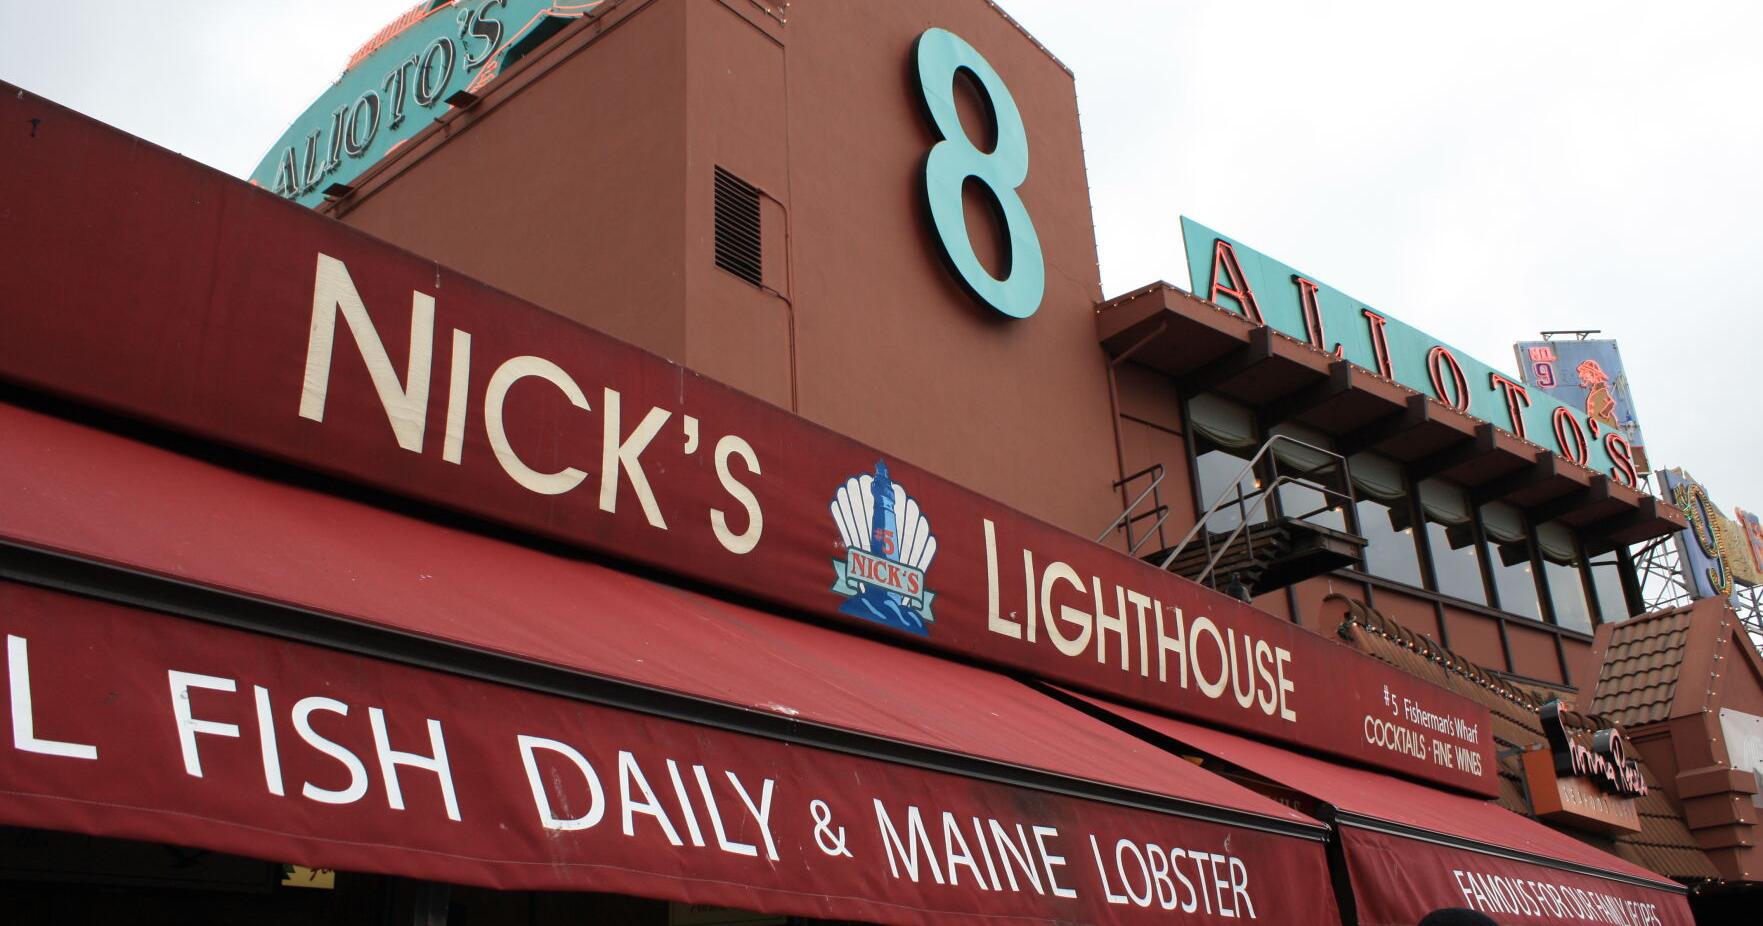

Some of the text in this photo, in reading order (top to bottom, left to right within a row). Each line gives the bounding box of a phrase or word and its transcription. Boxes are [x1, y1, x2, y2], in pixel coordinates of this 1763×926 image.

[271, 0, 504, 199] ALIOTO'S
[910, 27, 1045, 319] 8
[1208, 238, 1637, 488] ALIOTO'S
[1533, 362, 1558, 389] 9
[299, 252, 1297, 722] NICK'S LIGHTHOUSE
[851, 552, 919, 594] NICK'S
[1364, 715, 1426, 760] COCKTAILS
[1455, 745, 1482, 776] WINES
[1404, 698, 1455, 737] Fisherman's
[1454, 717, 1479, 745] Wharf
[168, 669, 461, 822] FISH
[517, 735, 780, 861] DAILY
[808, 799, 853, 857] &
[873, 798, 1077, 899] MAINE
[1089, 834, 1257, 919] LOBSTER
[1453, 870, 1541, 916] FAMOUS
[1527, 880, 1575, 919] FOR
[1560, 885, 1600, 921] OUR
